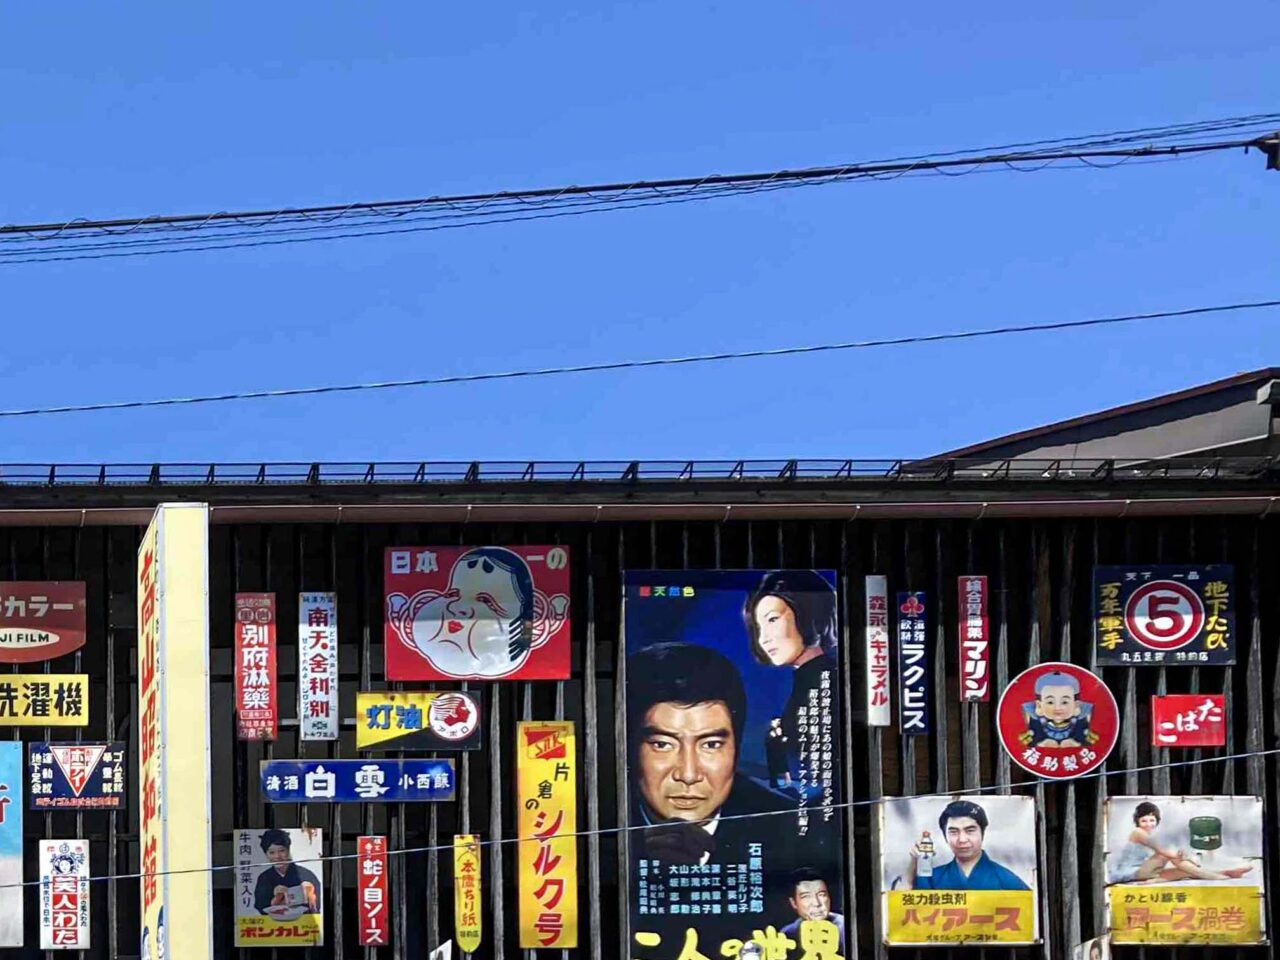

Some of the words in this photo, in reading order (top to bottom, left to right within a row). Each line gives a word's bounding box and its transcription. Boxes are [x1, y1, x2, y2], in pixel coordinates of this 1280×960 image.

[392, 551, 439, 574] 日本
[527, 548, 567, 570] 一の
[869, 596, 887, 626] 森永
[1204, 581, 1230, 650] 地下たび
[17, 633, 50, 643] FILM
[870, 641, 889, 706] キャラメル
[963, 641, 988, 698] マリン
[903, 644, 926, 729] ラクピス
[366, 704, 422, 730] 灯油
[1021, 748, 1097, 772] 福助製品
[266, 775, 299, 791] 清酒
[305, 764, 390, 798] 白雪
[52, 876, 79, 945] 美人わた
[902, 892, 967, 905] 強力殺虫剤
[902, 907, 1021, 931] ハイアース
[240, 926, 320, 939] ボンカレー
